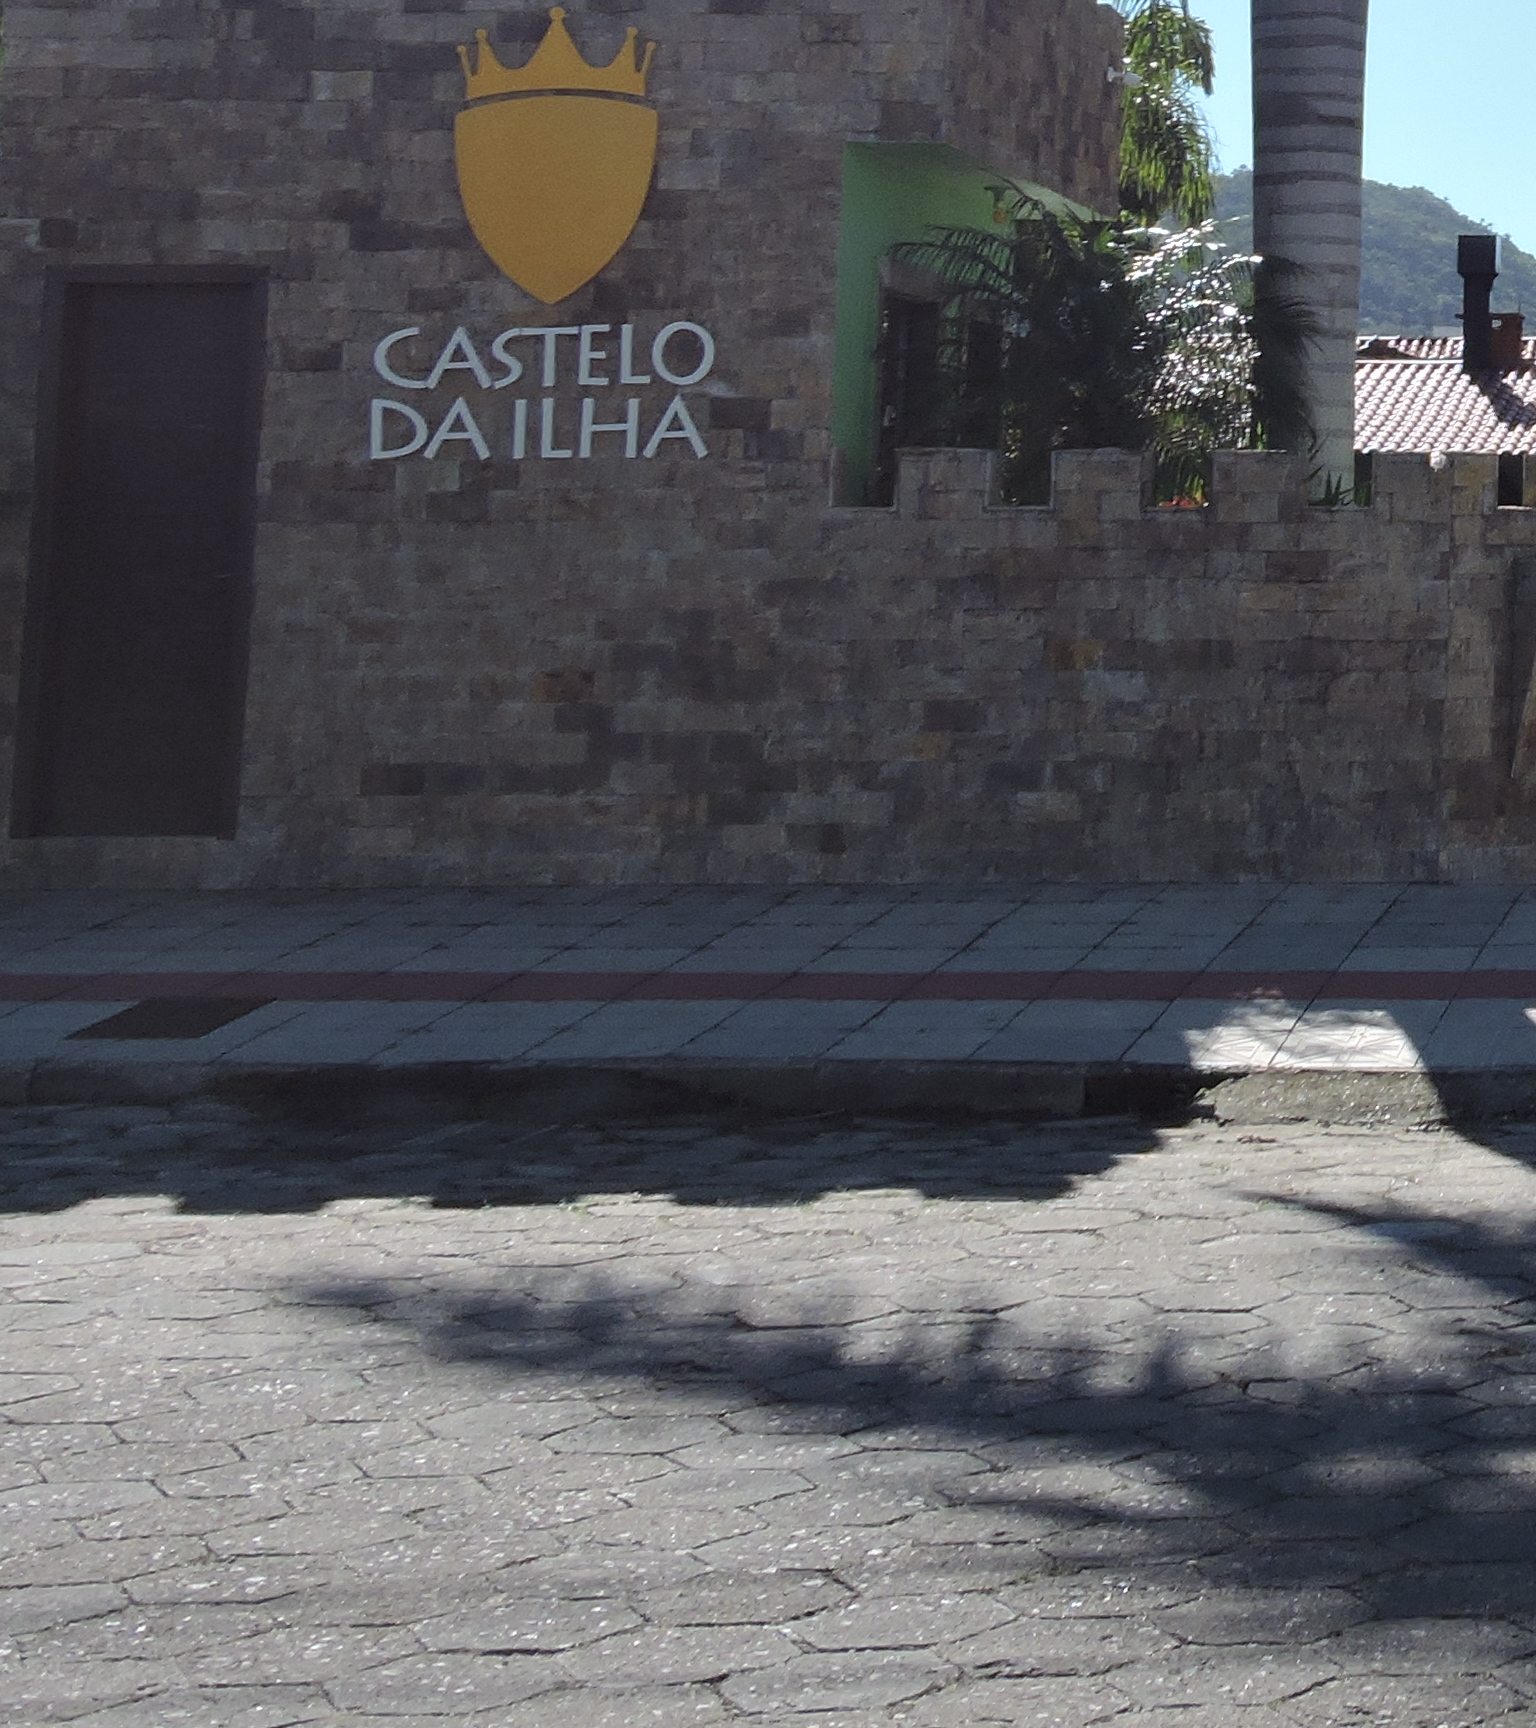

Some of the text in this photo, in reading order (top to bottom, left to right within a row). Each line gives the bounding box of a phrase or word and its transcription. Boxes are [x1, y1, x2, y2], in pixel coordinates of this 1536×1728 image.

[373, 321, 715, 389] CASTELO
[369, 393, 709, 460] DA ILHA
